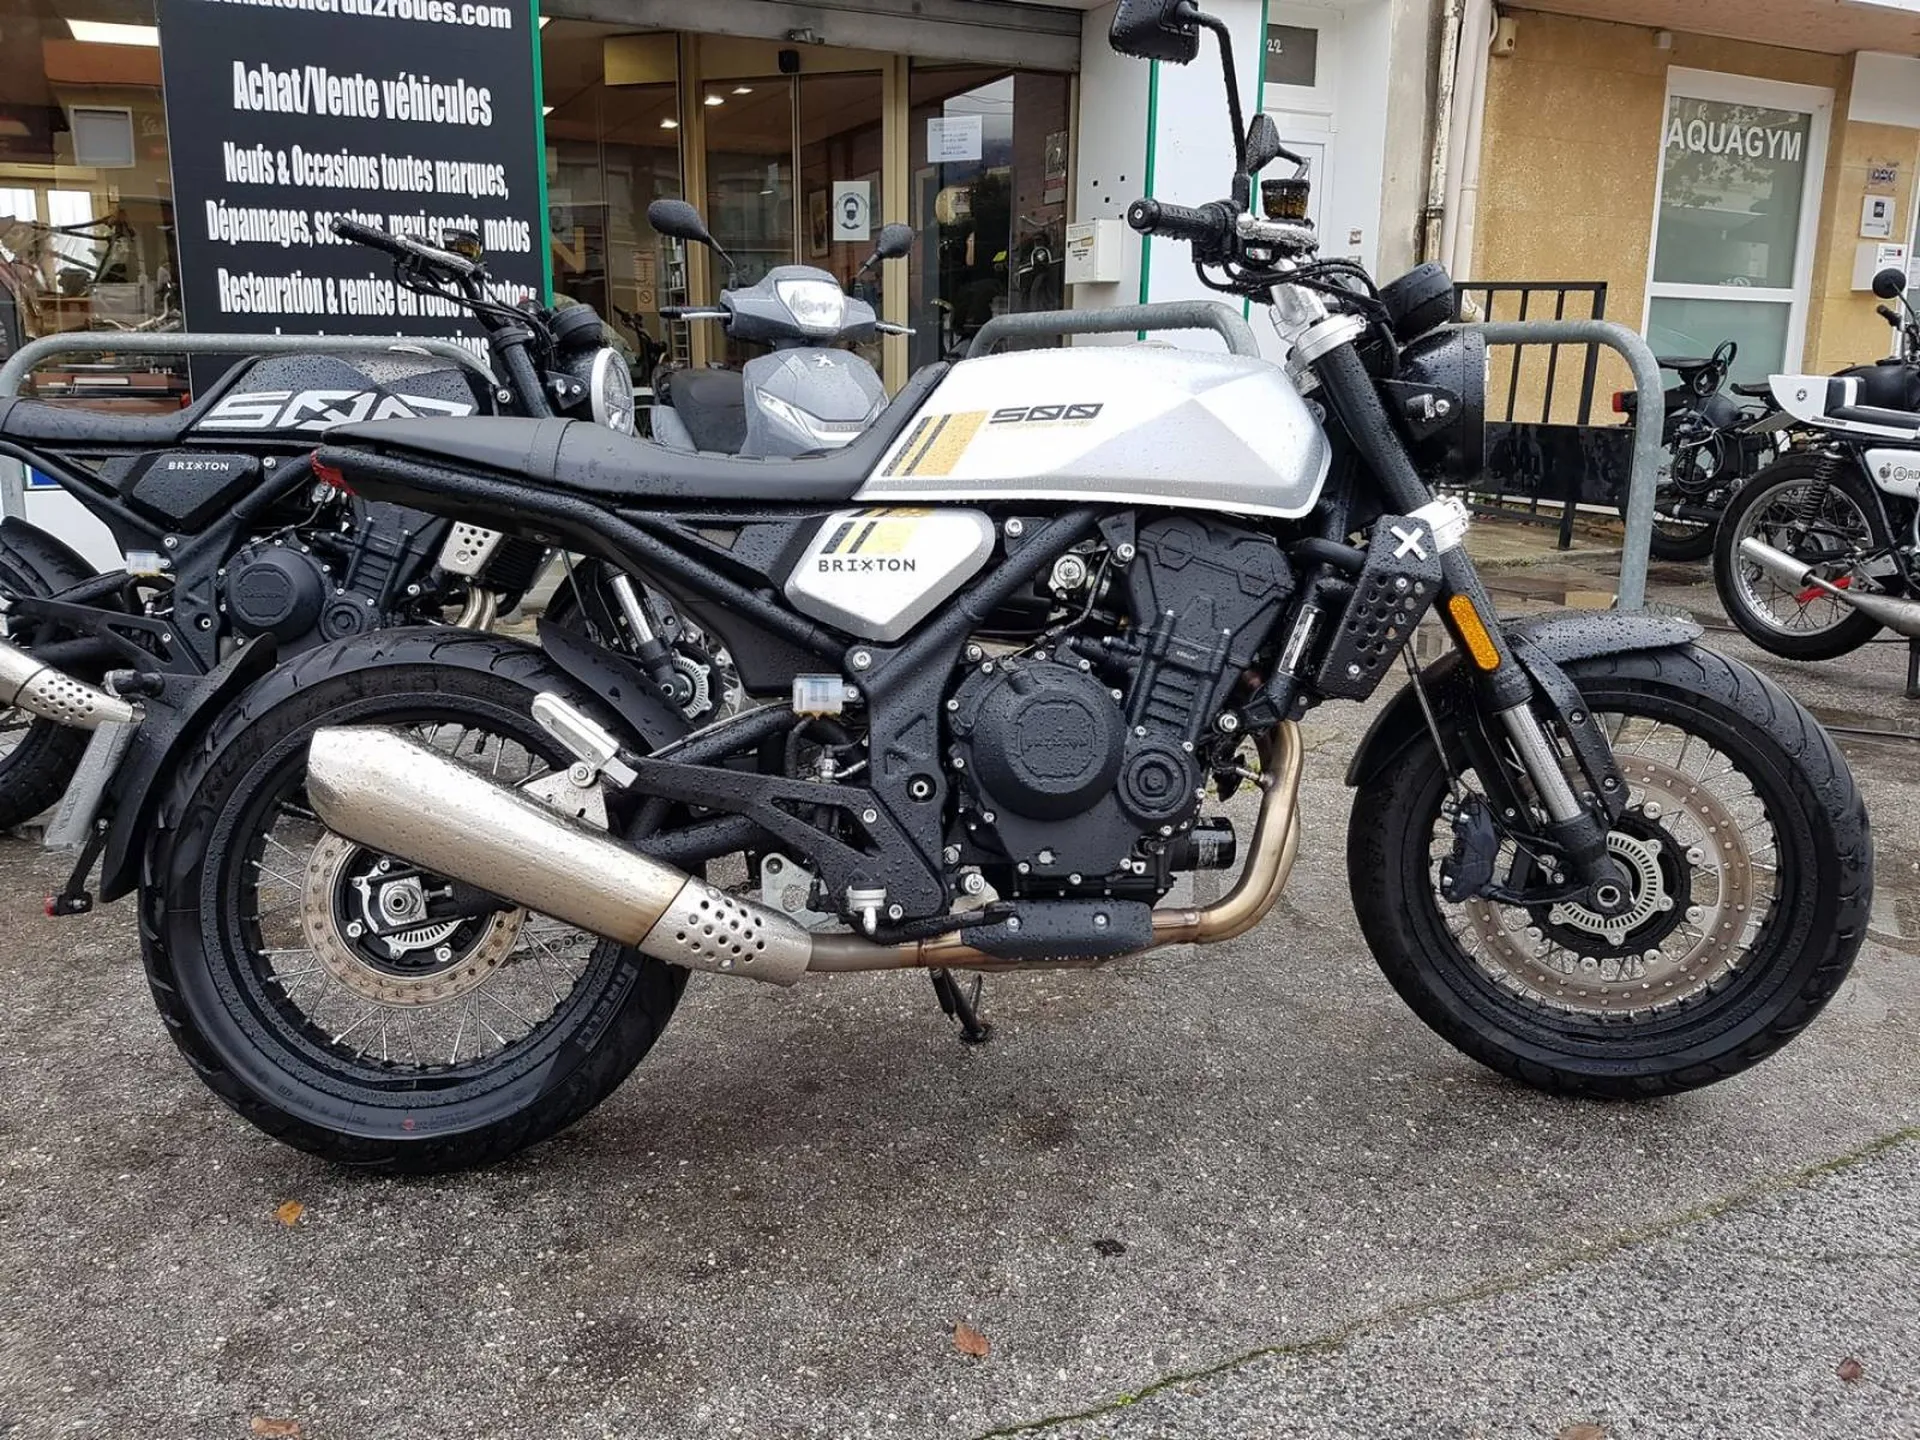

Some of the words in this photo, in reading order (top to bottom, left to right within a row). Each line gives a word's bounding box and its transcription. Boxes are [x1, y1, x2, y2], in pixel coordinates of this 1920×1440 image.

[233, 60, 379, 118] Achat/Vente
[382, 71, 493, 126] véhicules
[1664, 117, 1802, 162] AQUAGYM
[223, 141, 274, 184] Neufs
[277, 150, 291, 184] &
[291, 145, 379, 190] Occasions
[381, 153, 434, 192] toutes
[435, 158, 509, 200] marques,
[205, 199, 313, 248] Dépannages,
[484, 216, 530, 252] motos
[217, 267, 324, 314] Restauration
[326, 277, 338, 315] &
[339, 272, 395, 316] remise
[168, 461, 229, 471] BRIXTON
[818, 558, 916, 572] BRIXTON
